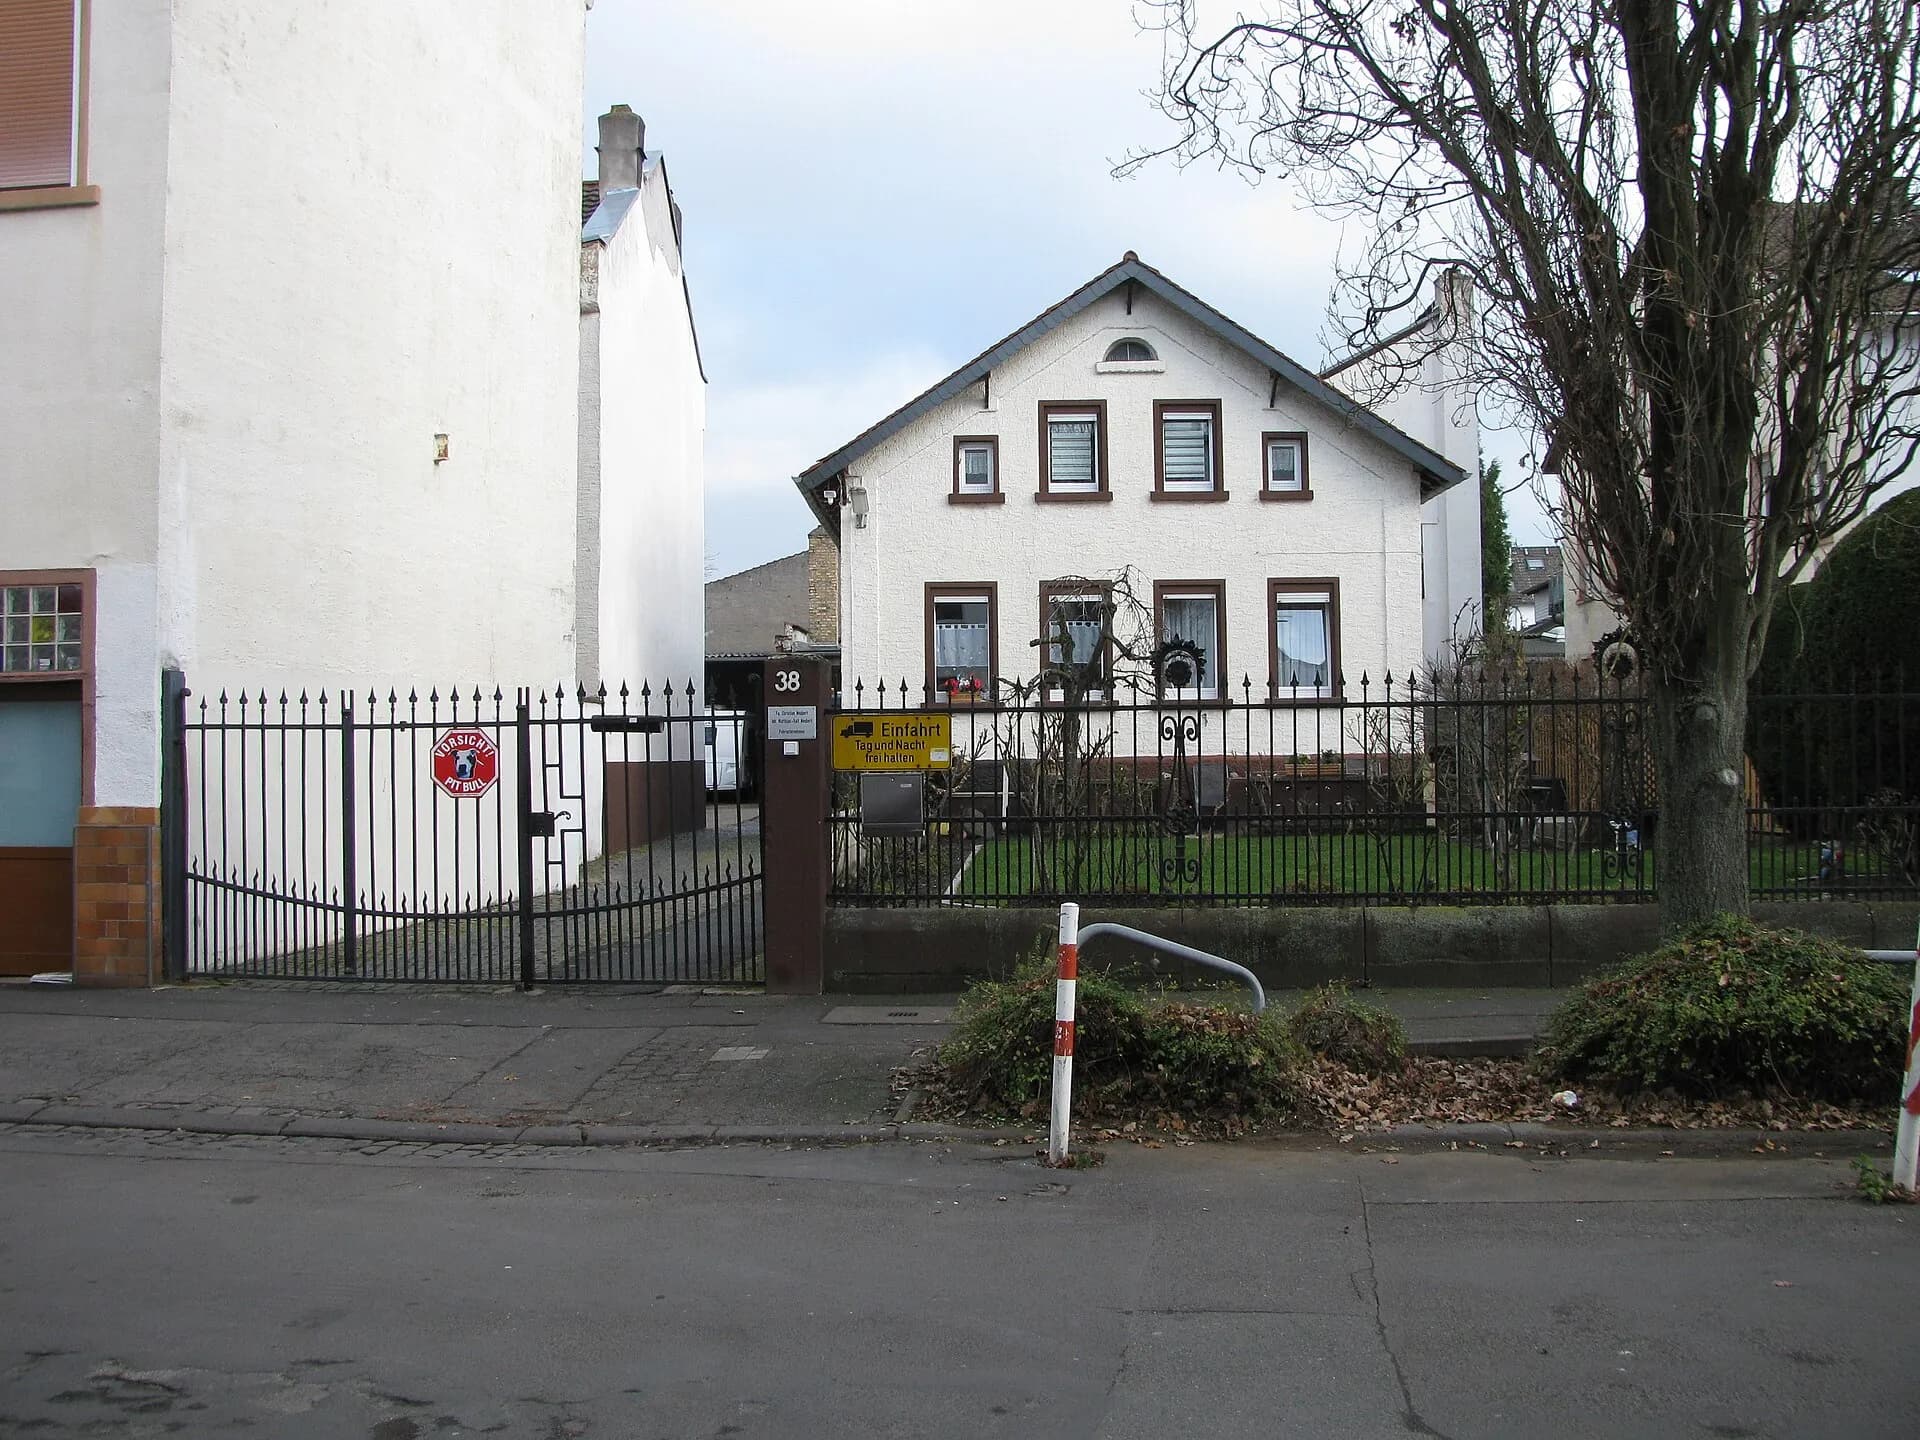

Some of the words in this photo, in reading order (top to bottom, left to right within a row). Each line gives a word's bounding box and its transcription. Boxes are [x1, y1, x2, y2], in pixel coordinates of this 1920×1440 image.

[775, 670, 800, 691] 38
[881, 722, 941, 737] Einfahrt
[435, 735, 494, 757] VORSICHT!
[855, 740, 873, 752] Tag
[874, 740, 894, 750] und
[895, 739, 925, 750] Nacht
[865, 752, 882, 762] frei
[883, 752, 914, 762] halten
[445, 777, 461, 790] PIT
[463, 778, 487, 791] BULL
